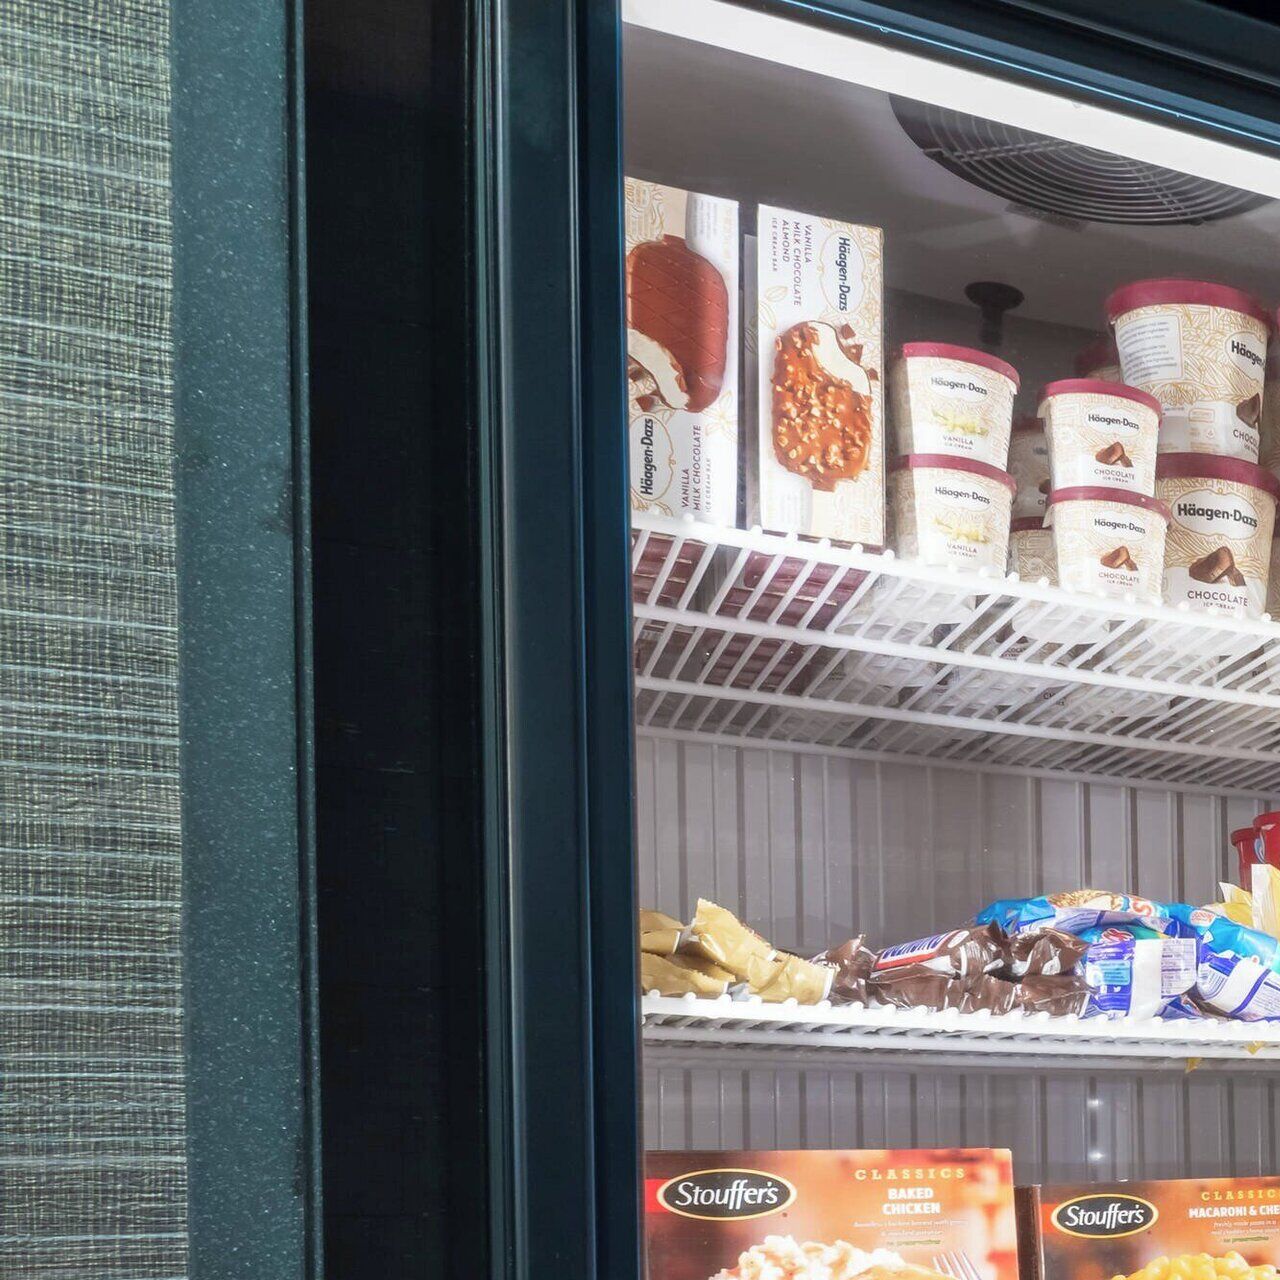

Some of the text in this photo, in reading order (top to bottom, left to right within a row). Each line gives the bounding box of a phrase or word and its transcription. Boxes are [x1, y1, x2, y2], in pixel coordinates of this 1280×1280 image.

[782, 219, 790, 262] ALMOND
[804, 225, 812, 263] VANILLA
[793, 248, 801, 306] CHOCOLATE
[693, 425, 701, 511] MILK CHOCOLATE
[1094, 468, 1135, 482] CHOCOLATE
[681, 468, 690, 508] VANILLA
[1099, 571, 1140, 585] CHOCOLATE
[1187, 590, 1248, 607] CHOCOLATE
[855, 1168, 966, 1181] CLASSICS
[887, 1187, 934, 1200] BAKED
[882, 1202, 941, 1215] CHICKEN
[1188, 1206, 1247, 1218] MACARONI
[1249, 1206, 1257, 1216] &
